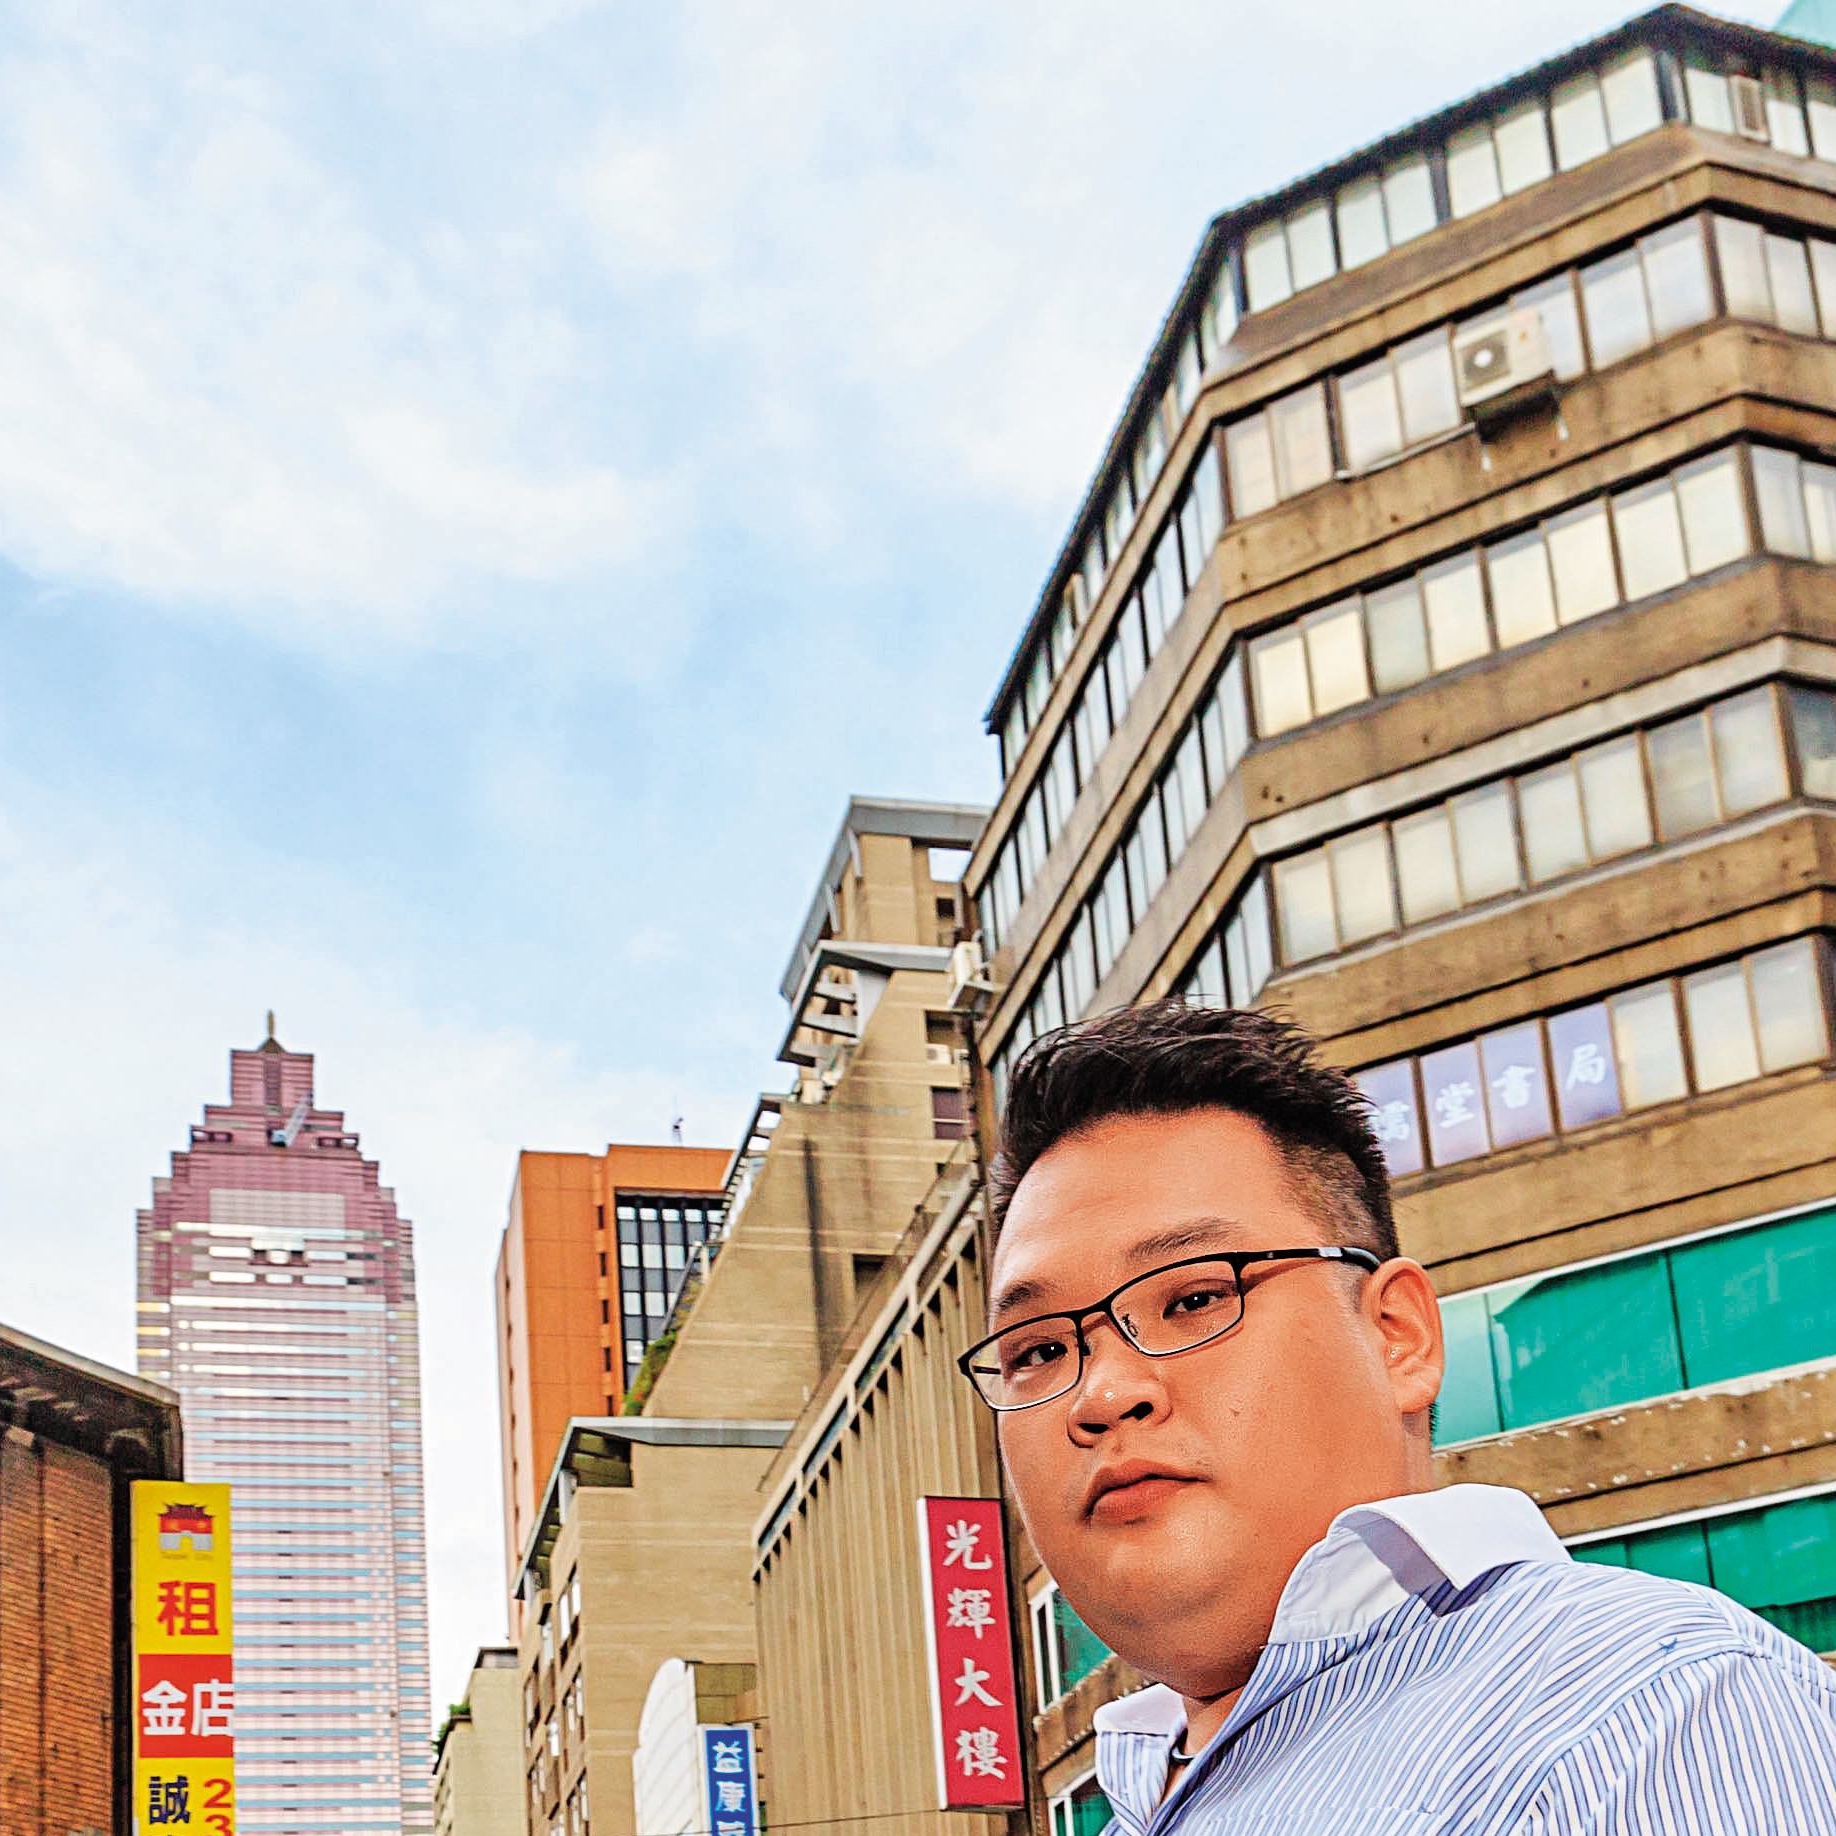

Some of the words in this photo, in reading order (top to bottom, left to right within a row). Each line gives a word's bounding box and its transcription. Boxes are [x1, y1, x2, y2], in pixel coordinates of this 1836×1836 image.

[157, 1580, 219, 1636] 租
[943, 1519, 1008, 1780] 光輝大樓
[142, 1679, 234, 1736] 金店
